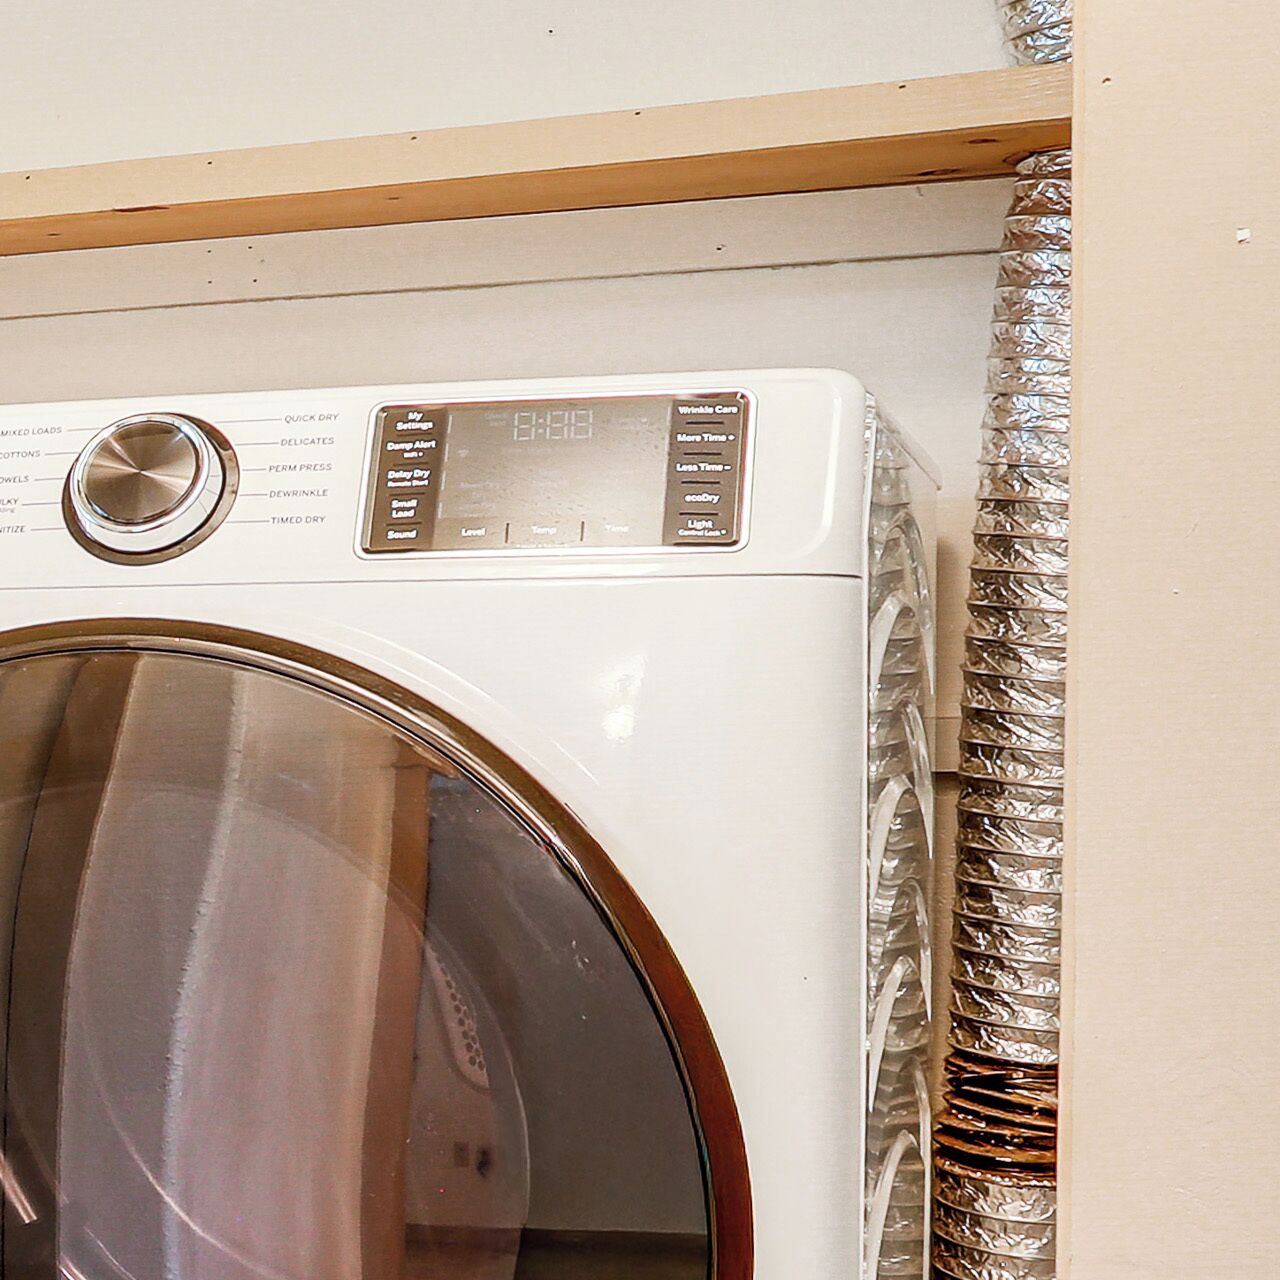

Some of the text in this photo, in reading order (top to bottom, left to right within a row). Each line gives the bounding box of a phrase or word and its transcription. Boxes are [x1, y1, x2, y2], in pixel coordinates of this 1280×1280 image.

[678, 405, 738, 414] Wrinkle Care
[284, 413, 340, 424] QUICK DRY
[408, 412, 424, 421] My
[396, 421, 434, 431] Settings
[0, 427, 62, 437] MIXED LOADS
[280, 437, 335, 446] DELICATES
[676, 433, 727, 442] More Time
[386, 440, 436, 451] Damp Alert
[268, 463, 333, 473] PERM PRESS
[676, 463, 724, 472] Less Time
[387, 469, 431, 480] Delay Dry
[269, 489, 329, 498] DEWRINKLE
[685, 493, 720, 504] ecoDry
[392, 499, 418, 508] Small
[392, 509, 415, 518] Load
[271, 515, 326, 525] TIMED DRY
[688, 520, 713, 529] Light
[387, 530, 417, 539] Sound
[461, 528, 486, 537] Level
[531, 525, 558, 536] Temp
